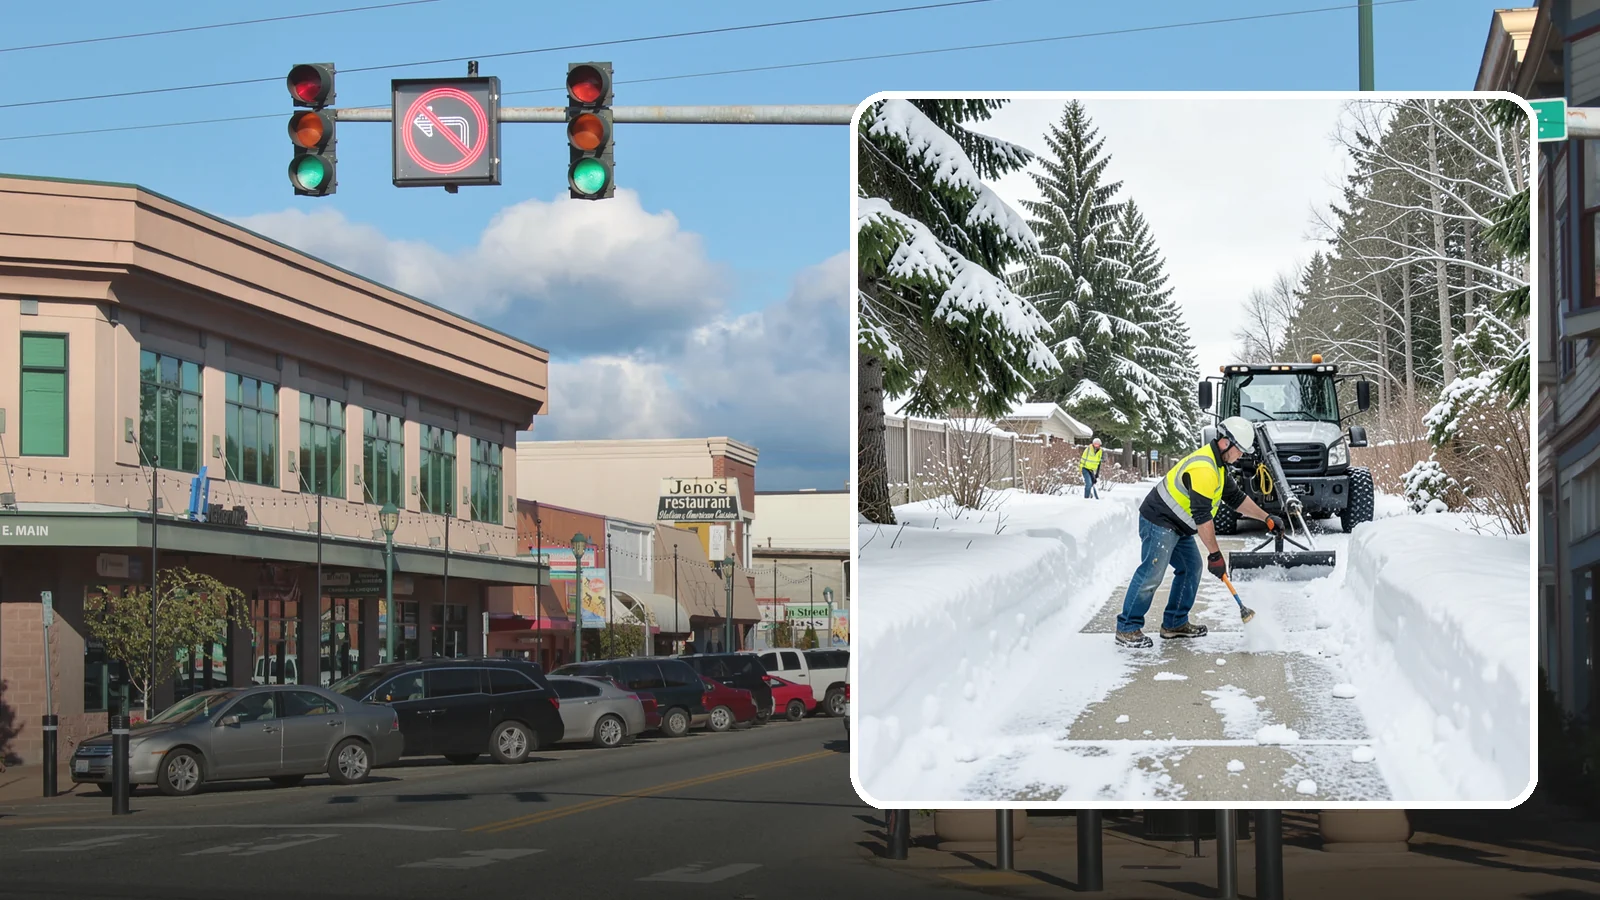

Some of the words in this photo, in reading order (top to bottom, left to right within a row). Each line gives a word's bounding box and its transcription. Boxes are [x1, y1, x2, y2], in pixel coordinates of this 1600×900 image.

[670, 480, 728, 494] Jeno's
[665, 496, 731, 509] restaurant
[658, 510, 682, 519] Italian
[686, 510, 714, 519] American
[715, 509, 737, 519] Cuisine
[2, 525, 13, 536] E.
[15, 525, 49, 536] MAIN
[797, 608, 829, 617] Street
[790, 619, 824, 627] lass
